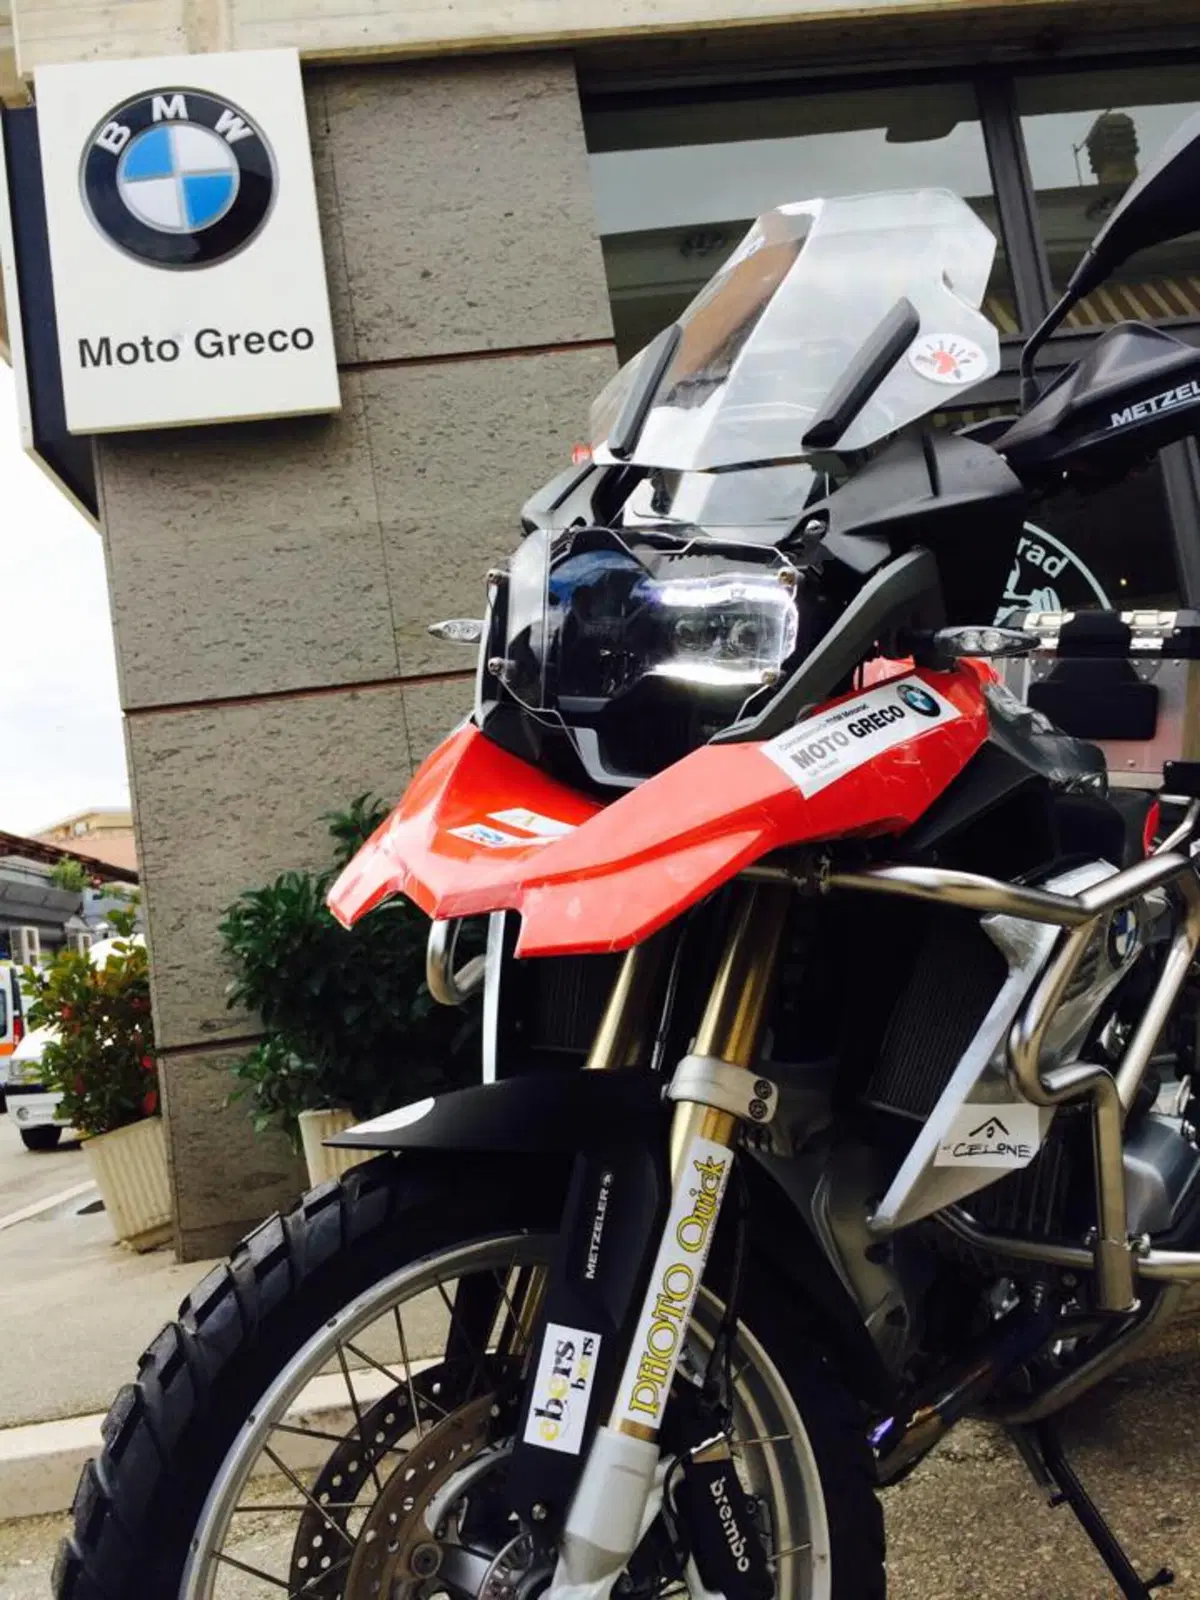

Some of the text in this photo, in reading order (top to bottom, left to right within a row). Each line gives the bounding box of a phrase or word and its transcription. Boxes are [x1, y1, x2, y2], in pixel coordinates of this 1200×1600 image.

[97, 94, 253, 155] BMW
[78, 327, 314, 368] Moto Greco
[790, 731, 850, 770] MOTO
[847, 705, 906, 738] GRECO
[585, 1187, 609, 1279] METZELER
[629, 1263, 694, 1418] PHOTO
[676, 1155, 725, 1253] Quick
[710, 1476, 749, 1572] brembo
